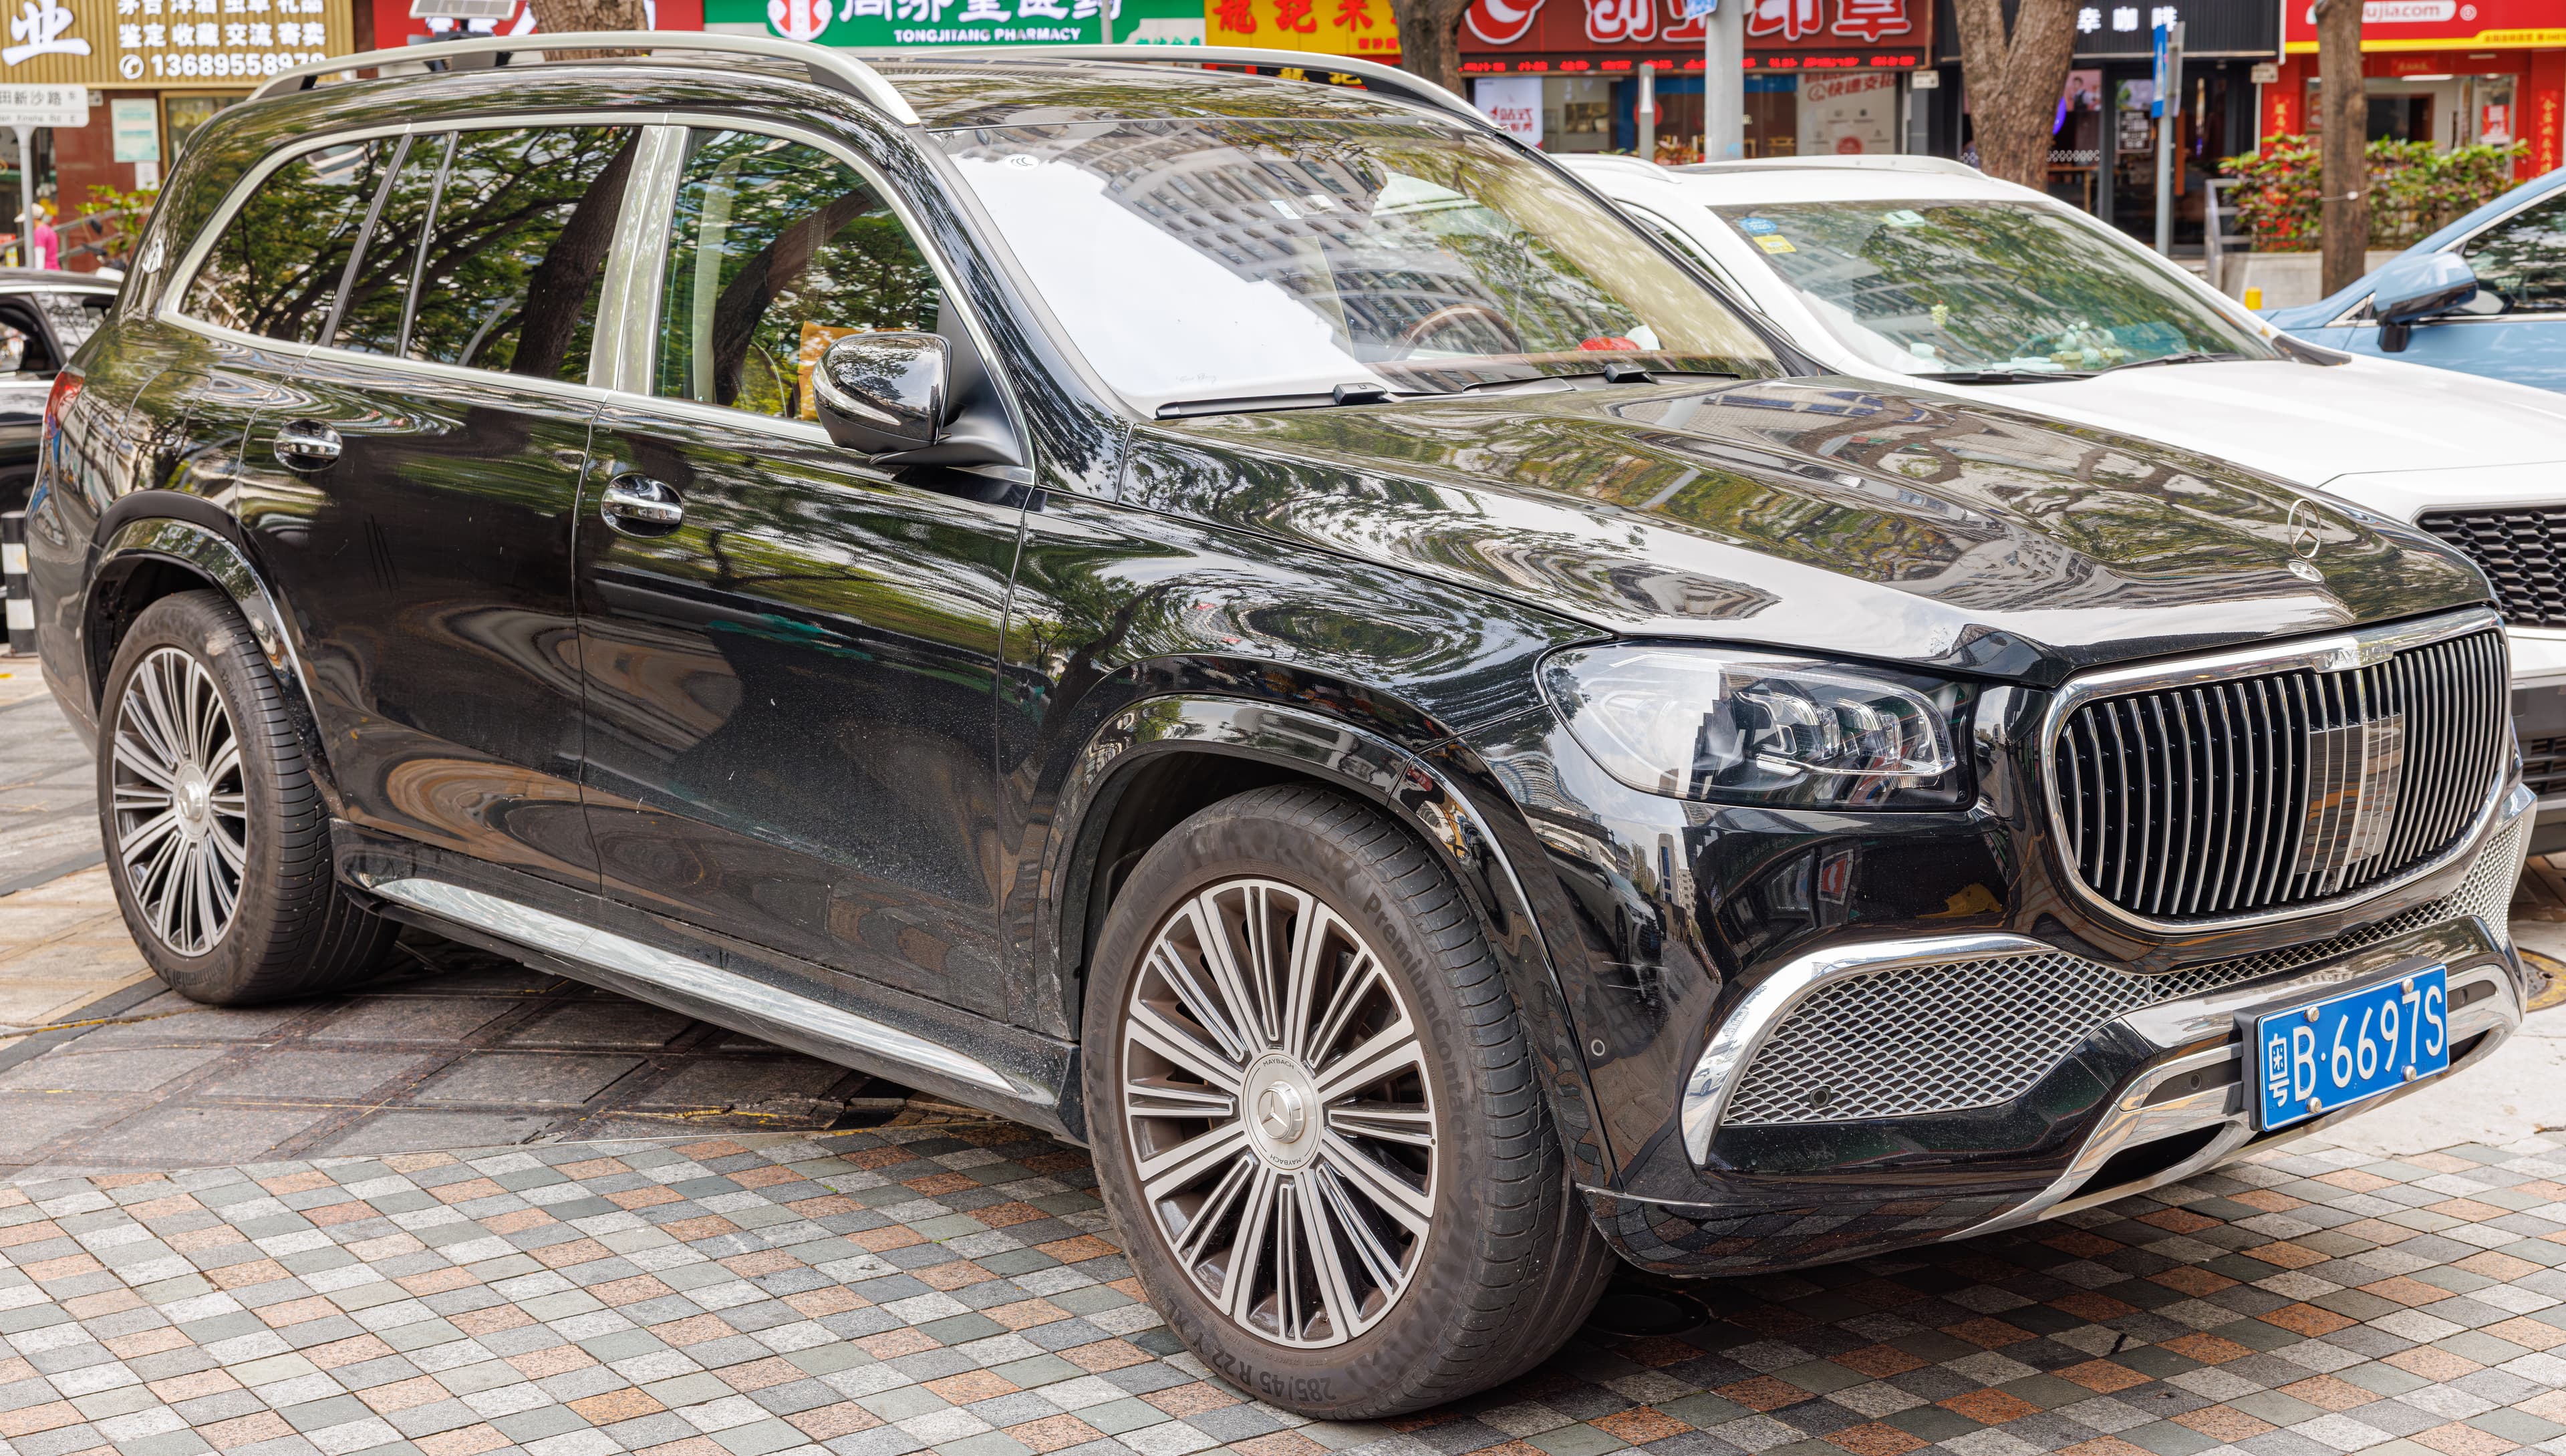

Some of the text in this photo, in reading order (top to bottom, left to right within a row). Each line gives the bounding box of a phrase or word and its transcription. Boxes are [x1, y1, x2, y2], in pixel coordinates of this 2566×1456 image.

[2364, 3, 2440, 22] ujia.com
[1, 0, 92, 67] 业
[119, 21, 326, 48] 鉴定 收藏 交流 寄卖
[893, 27, 1081, 43] TONGJITANG PHARMACY
[2322, 641, 2388, 668] MAYBACH
[2268, 986, 2444, 1107] 粤B·6697S
[1263, 1058, 1294, 1070] MAYBACH
[1270, 1154, 1301, 1166] MAYBACH
[1260, 1370, 1336, 1403] 285/45
